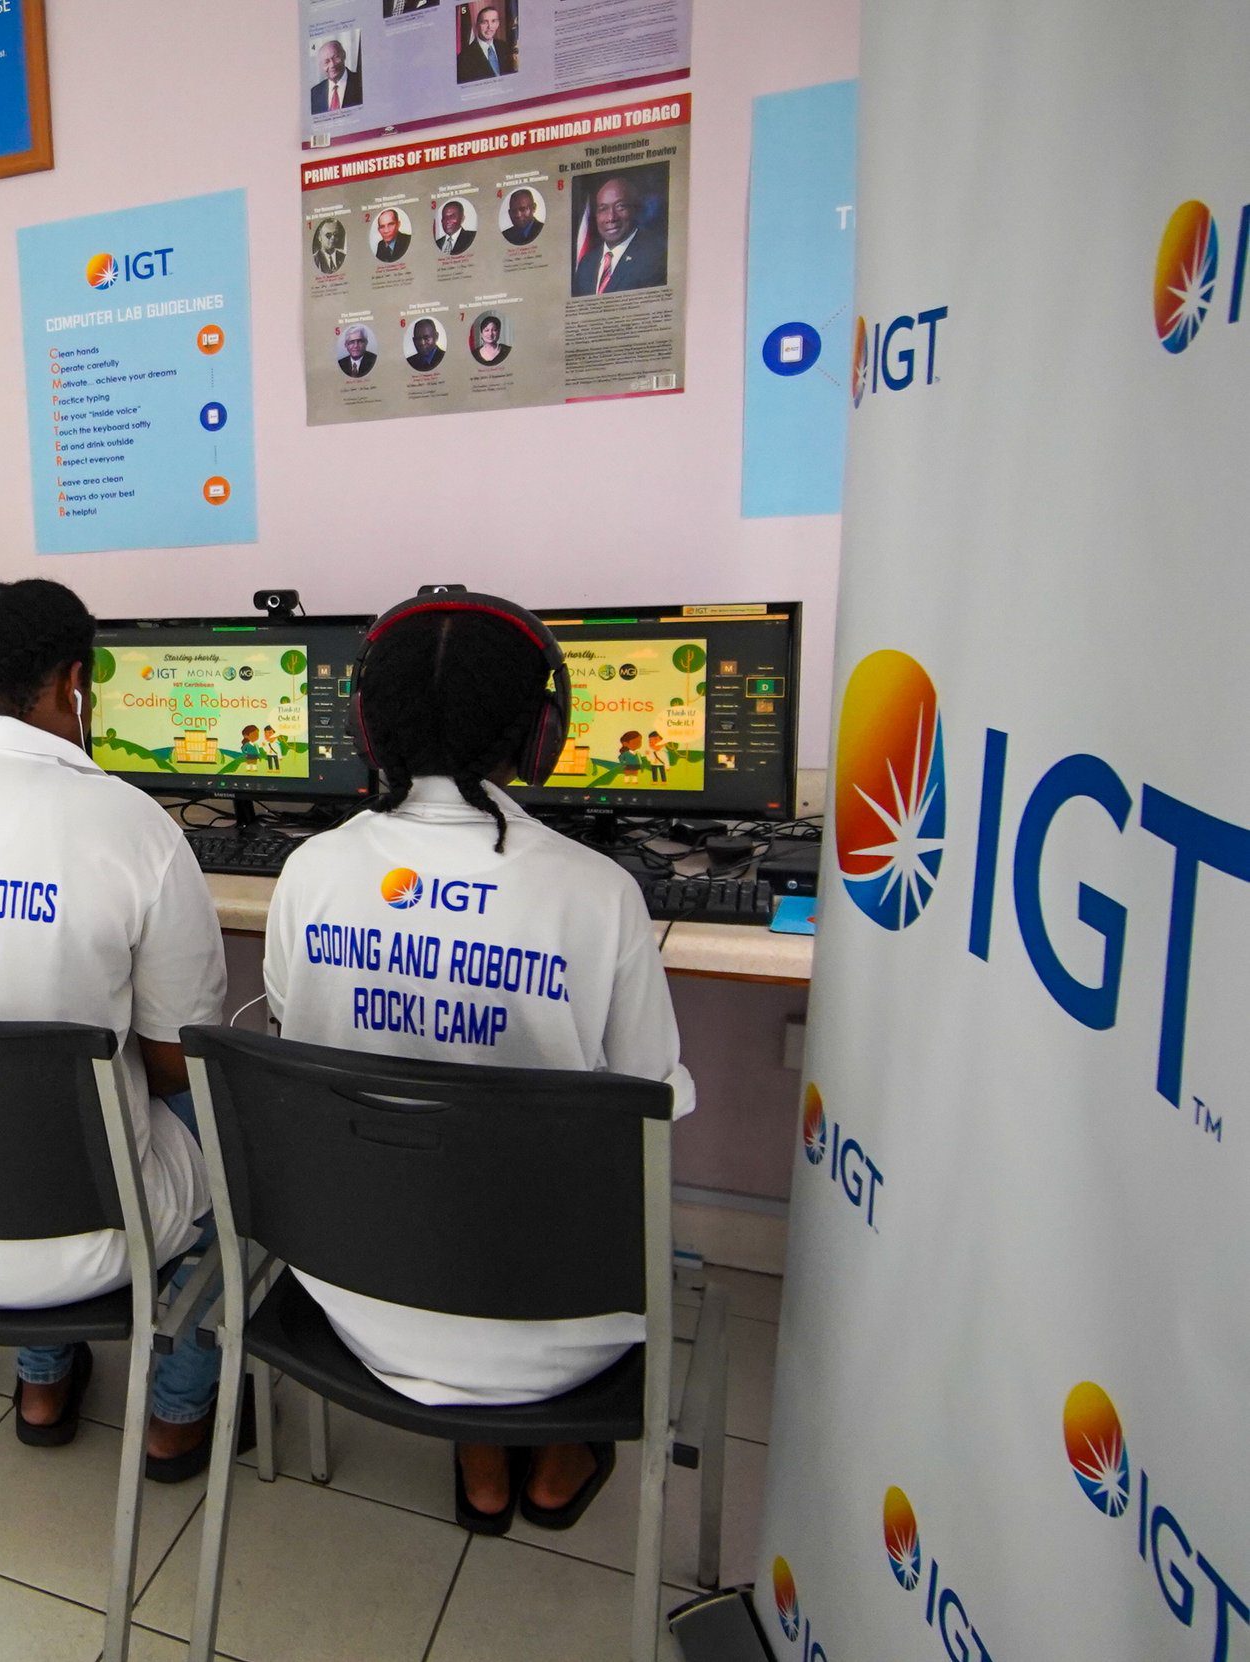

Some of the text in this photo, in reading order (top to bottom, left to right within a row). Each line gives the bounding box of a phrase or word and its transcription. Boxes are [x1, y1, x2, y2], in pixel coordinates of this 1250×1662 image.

[304, 103, 681, 184] PRIME MINISTERS OF THE REPUBLIC OF TRINIDAD AND TOBAGO
[585, 146, 600, 157] The
[571, 159, 592, 171] Keith
[595, 152, 644, 168] Christopher
[646, 146, 677, 159] Rowley
[124, 248, 174, 282] IGT
[45, 294, 224, 333] COMPUTER LAB GUIDELINES
[334, 326, 341, 336] 5
[49, 347, 99, 359] Clean hands
[872, 305, 948, 394] IGT
[51, 360, 119, 375] Operate carefully
[96, 374, 127, 385] achieve
[129, 373, 146, 382] your
[147, 369, 177, 379] dreams
[52, 393, 110, 406] Practice typing
[53, 411, 69, 422] Use
[70, 412, 87, 422] your
[54, 420, 151, 437] Touch the keyboard softly
[55, 437, 134, 452] Eat and drink outside
[56, 455, 125, 467] Respect everyone
[57, 475, 124, 487] Leave area clean
[58, 491, 87, 502] Always
[100, 492, 117, 501] your
[58, 507, 97, 517] Be helpful
[157, 668, 221, 679] IGT MONA
[123, 693, 268, 712] Coding & Robotics
[571, 695, 654, 712] Robotics
[171, 712, 217, 730] Camp
[430, 878, 498, 914] IGT
[969, 727, 1250, 1143] IGT TM
[306, 923, 569, 1002] CODING AND ROBOTIC
[354, 987, 507, 1047] ROCK! CAMP
[832, 1122, 884, 1227] IGT
